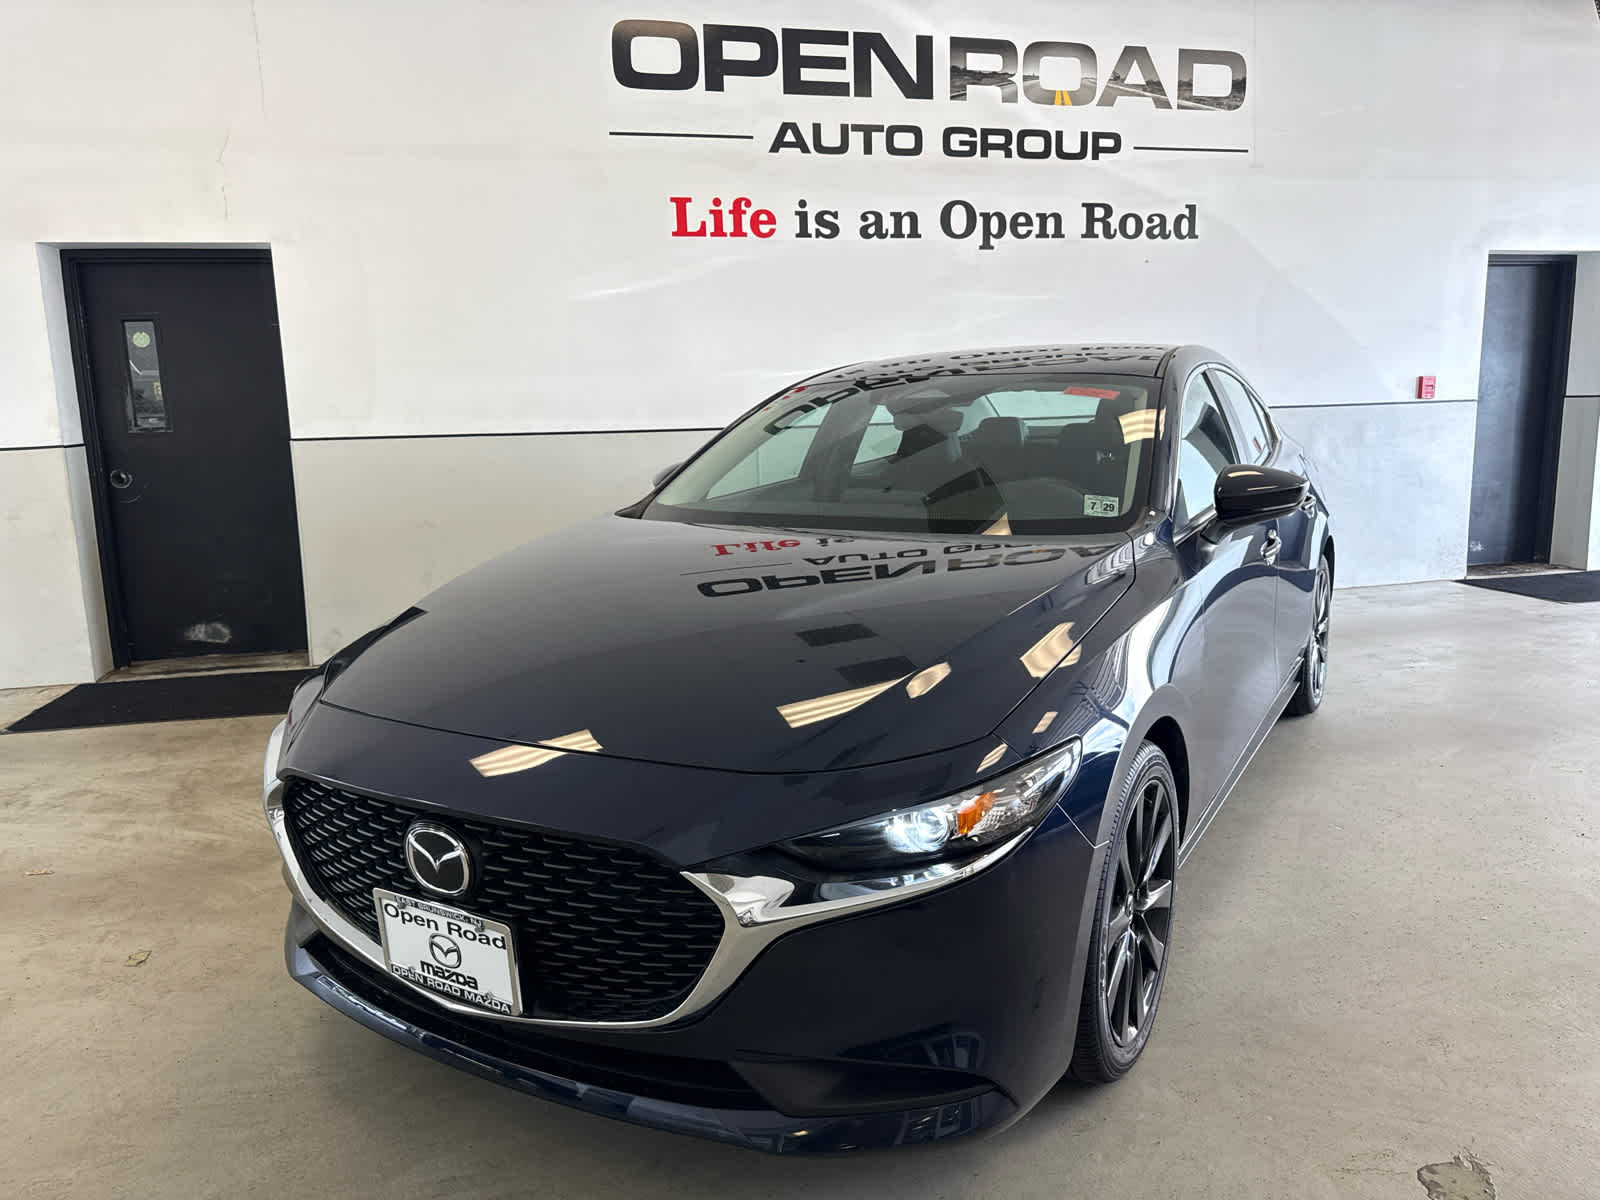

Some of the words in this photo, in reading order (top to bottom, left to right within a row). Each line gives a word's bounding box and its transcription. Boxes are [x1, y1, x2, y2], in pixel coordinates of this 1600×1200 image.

[611, 19, 933, 100] OPEN
[949, 36, 1247, 111] ROAD
[768, 121, 923, 157] AUTO
[942, 126, 1122, 161] GROUP
[670, 196, 777, 239] Life
[795, 199, 840, 239] is
[859, 210, 922, 240] an
[940, 200, 1065, 250] Open
[1081, 202, 1199, 241] Road
[1090, 501, 1097, 511] 7
[1103, 502, 1115, 512] 29
[384, 903, 439, 931] Open
[447, 921, 507, 950] Road
[393, 965, 424, 983] OPEN
[427, 978, 461, 996] ROAD
[464, 990, 511, 1014] MAZDA
[420, 960, 478, 990] mazda
